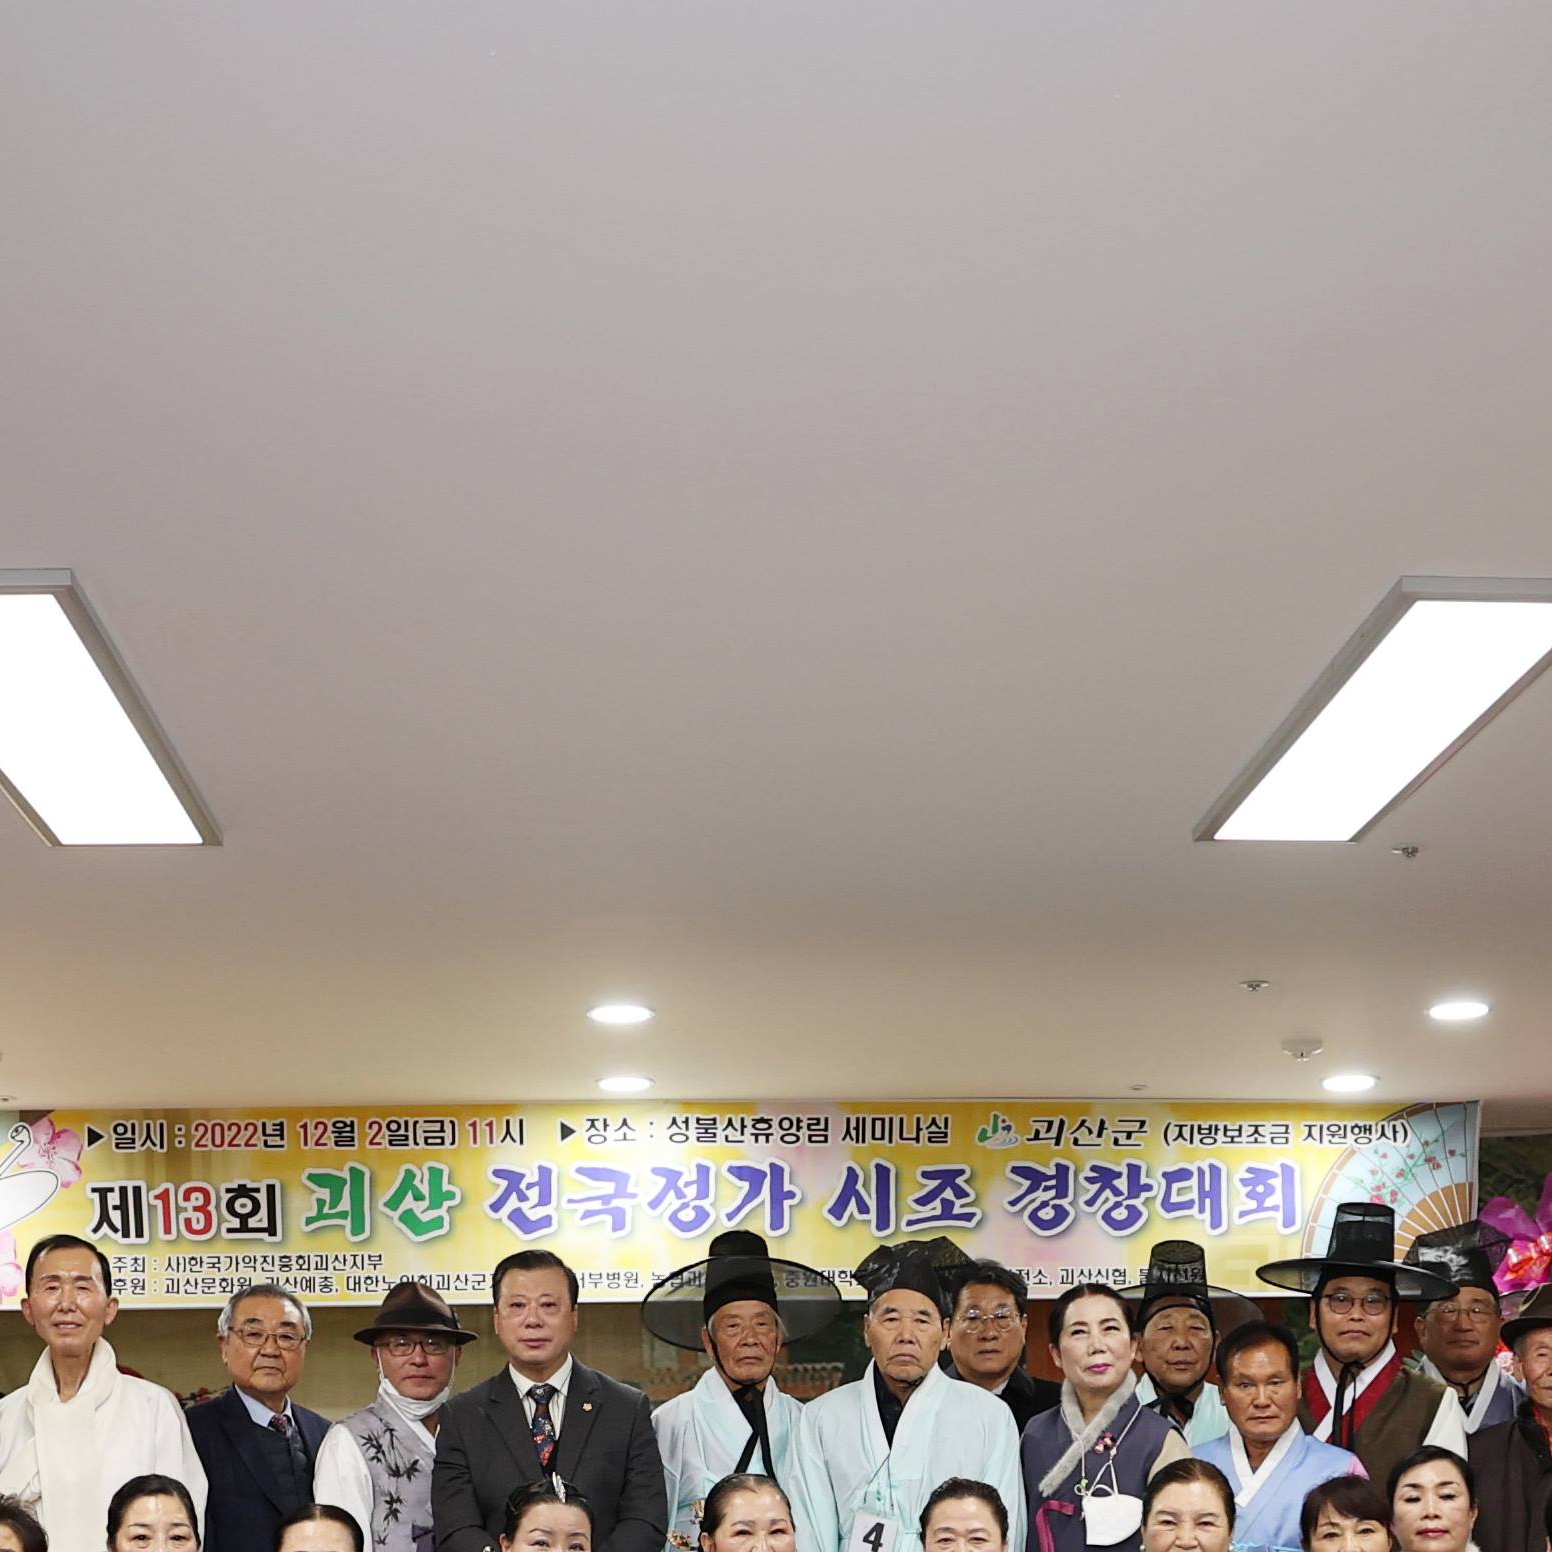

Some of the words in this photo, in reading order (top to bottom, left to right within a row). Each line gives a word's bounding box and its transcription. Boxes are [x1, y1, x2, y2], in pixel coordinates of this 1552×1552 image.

[193, 1121, 285, 1149] 2022년
[299, 1119, 356, 1148] 12월
[367, 1119, 457, 1147] 2일(금)
[467, 1118, 525, 1146] 11시
[666, 1116, 830, 1145] 성불산휴양림
[841, 1115, 949, 1146] 세미나실
[1026, 1117, 1148, 1147] 괴산군
[1163, 1121, 1291, 1147] (지방보조금
[1302, 1120, 1409, 1147] 지원행사)
[90, 1183, 278, 1239] 제13회
[305, 1165, 457, 1237] 괴산
[489, 1162, 796, 1235] 전국정가
[827, 1162, 978, 1232] 시조
[1007, 1162, 1296, 1231] 경창대회
